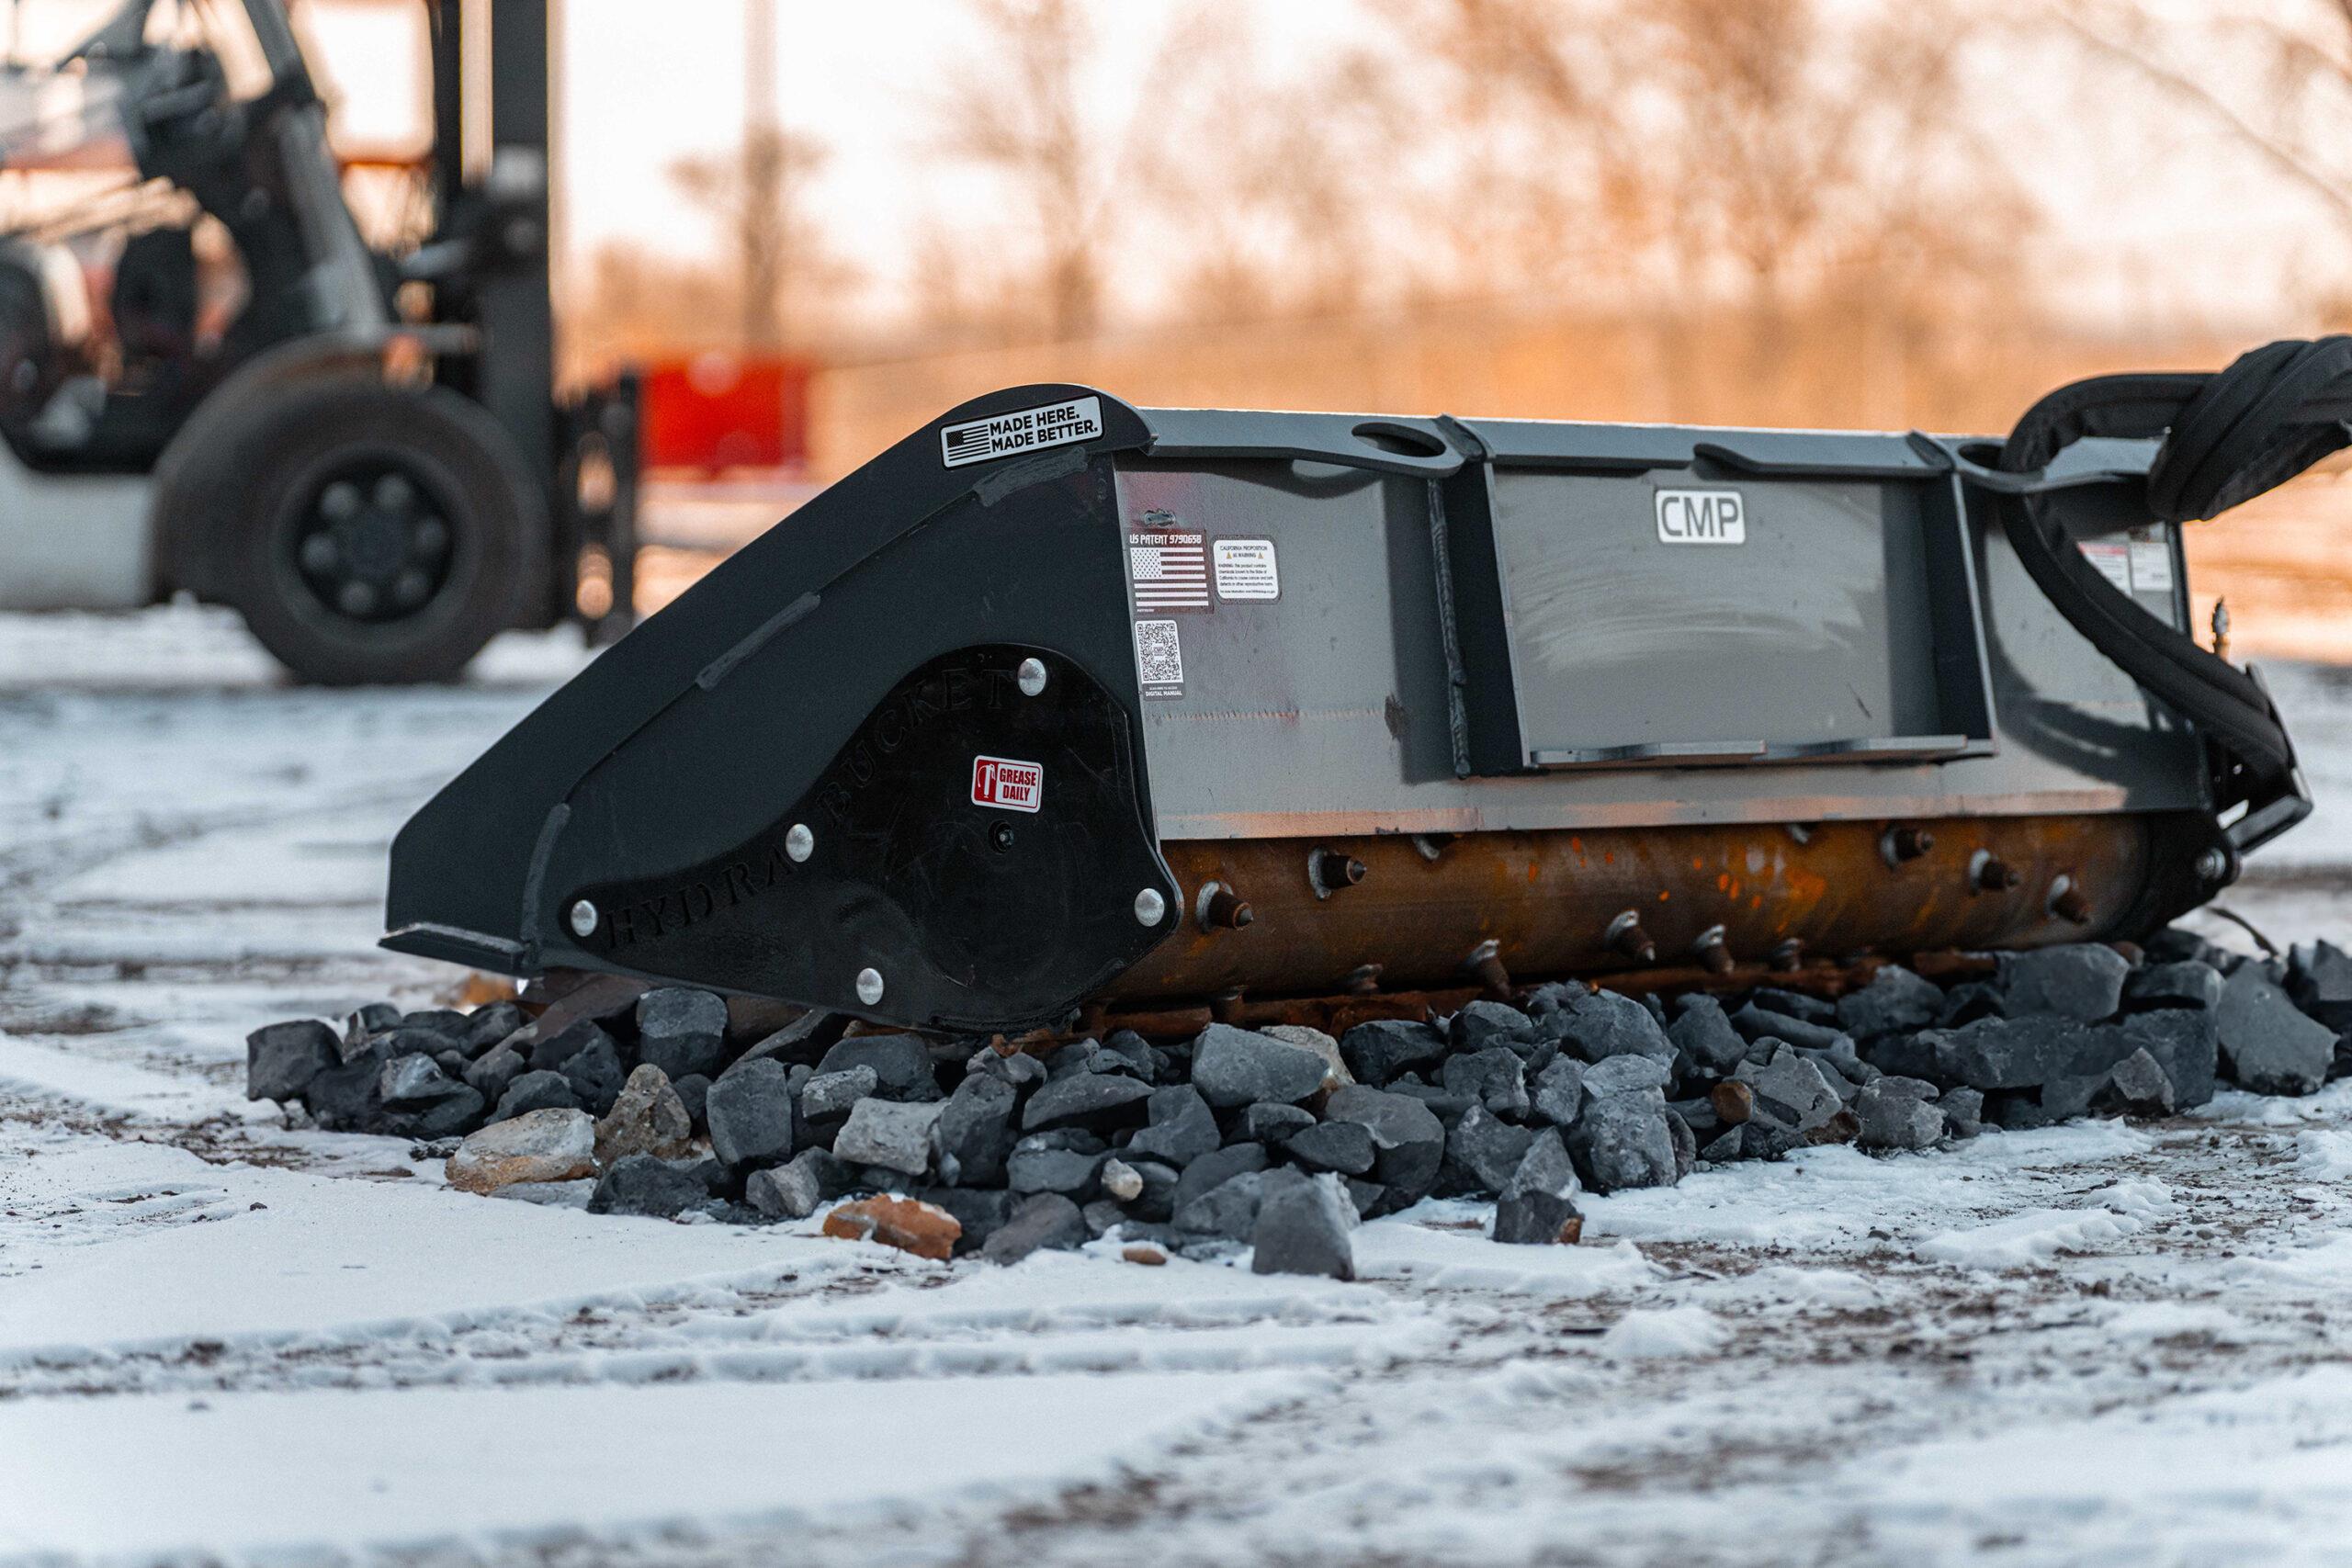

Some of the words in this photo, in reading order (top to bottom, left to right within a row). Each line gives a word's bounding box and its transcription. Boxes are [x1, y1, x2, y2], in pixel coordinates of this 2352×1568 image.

[989, 415, 1033, 436] MADE
[1036, 406, 1080, 427] HERE.
[991, 431, 1035, 453] MADE
[1037, 420, 1099, 444] BETTER.
[1661, 496, 1739, 536] CMP
[1129, 534, 1139, 544] US
[1140, 534, 1169, 546] PATENT
[999, 768, 1036, 786] GREASE
[1002, 784, 1031, 802] DAILY
[605, 844, 798, 950] HYDRA
[815, 668, 1018, 827] BUCKET
